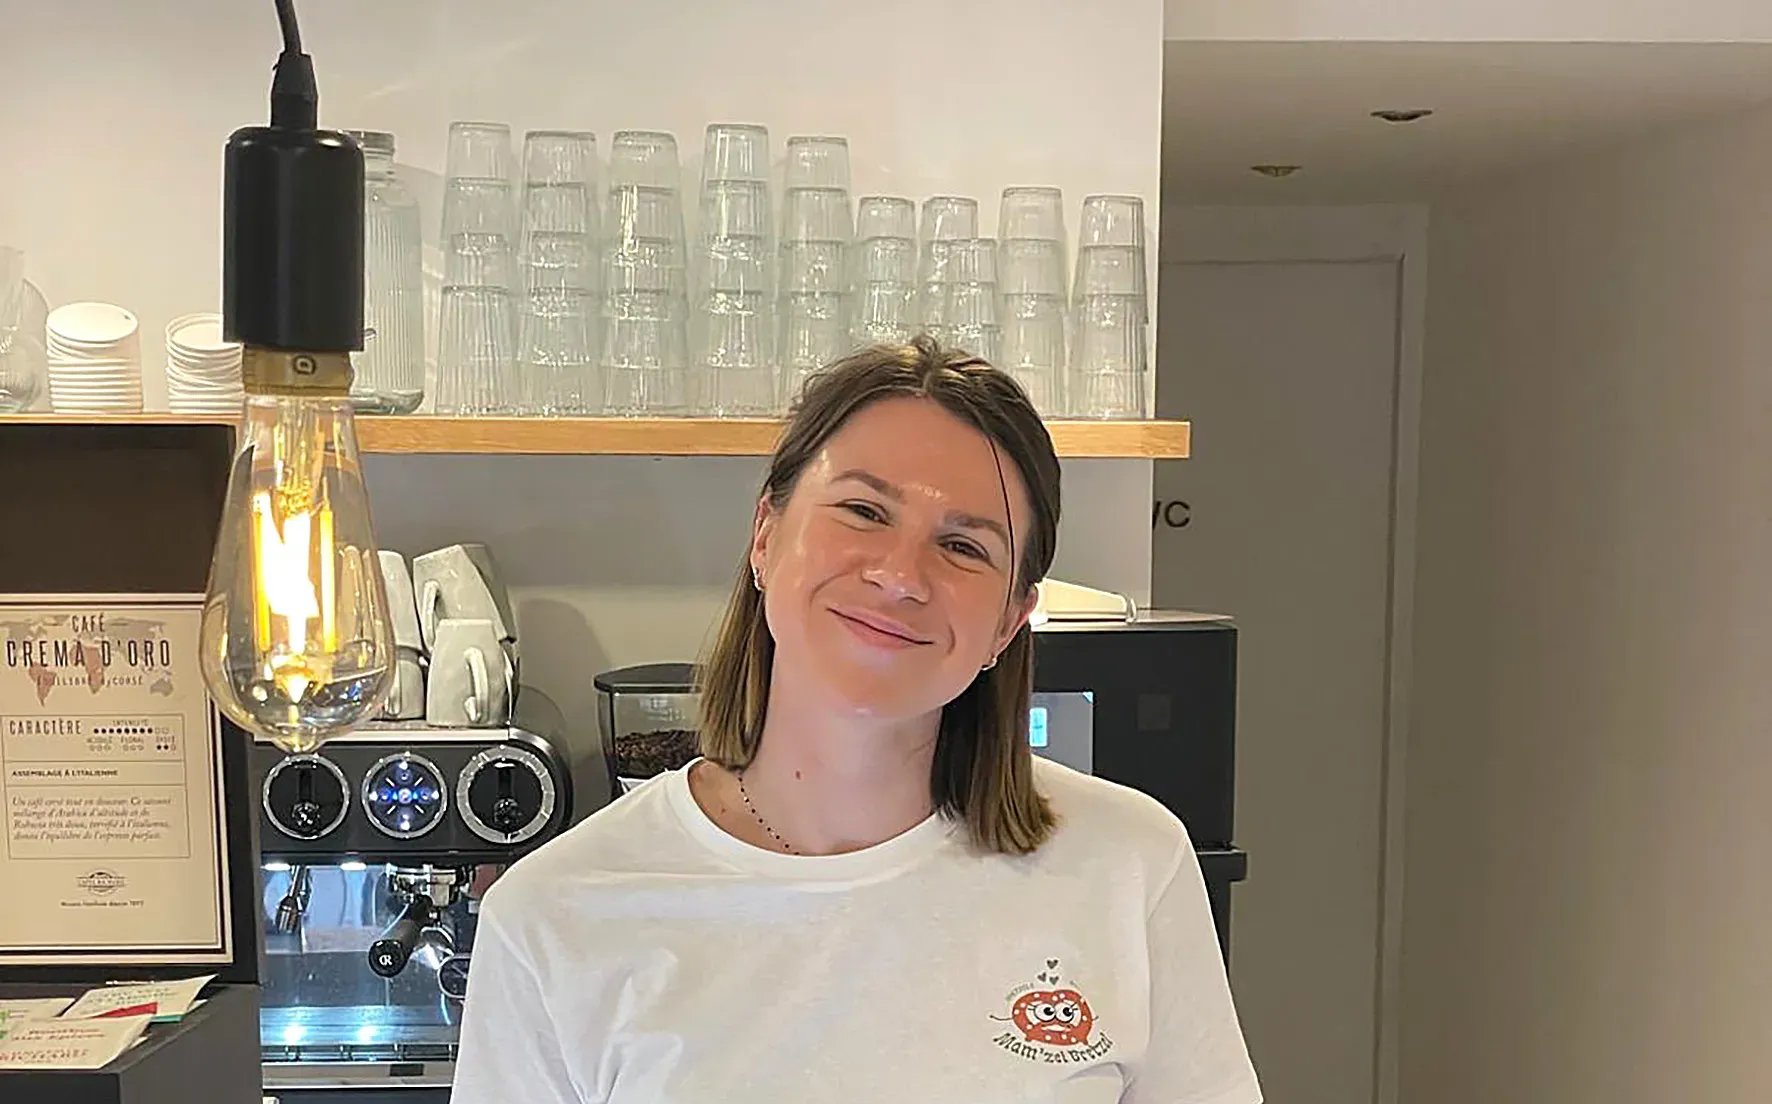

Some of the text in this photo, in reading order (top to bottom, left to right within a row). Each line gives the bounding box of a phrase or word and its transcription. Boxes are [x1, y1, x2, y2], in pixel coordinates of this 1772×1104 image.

[1151, 500, 1190, 528] C
[71, 613, 106, 633] CAFÉ
[6, 639, 171, 668] CREMA D'ORO
[9, 718, 83, 736] CARACTÈRE
[12, 769, 63, 778] ASSEMBLAGE
